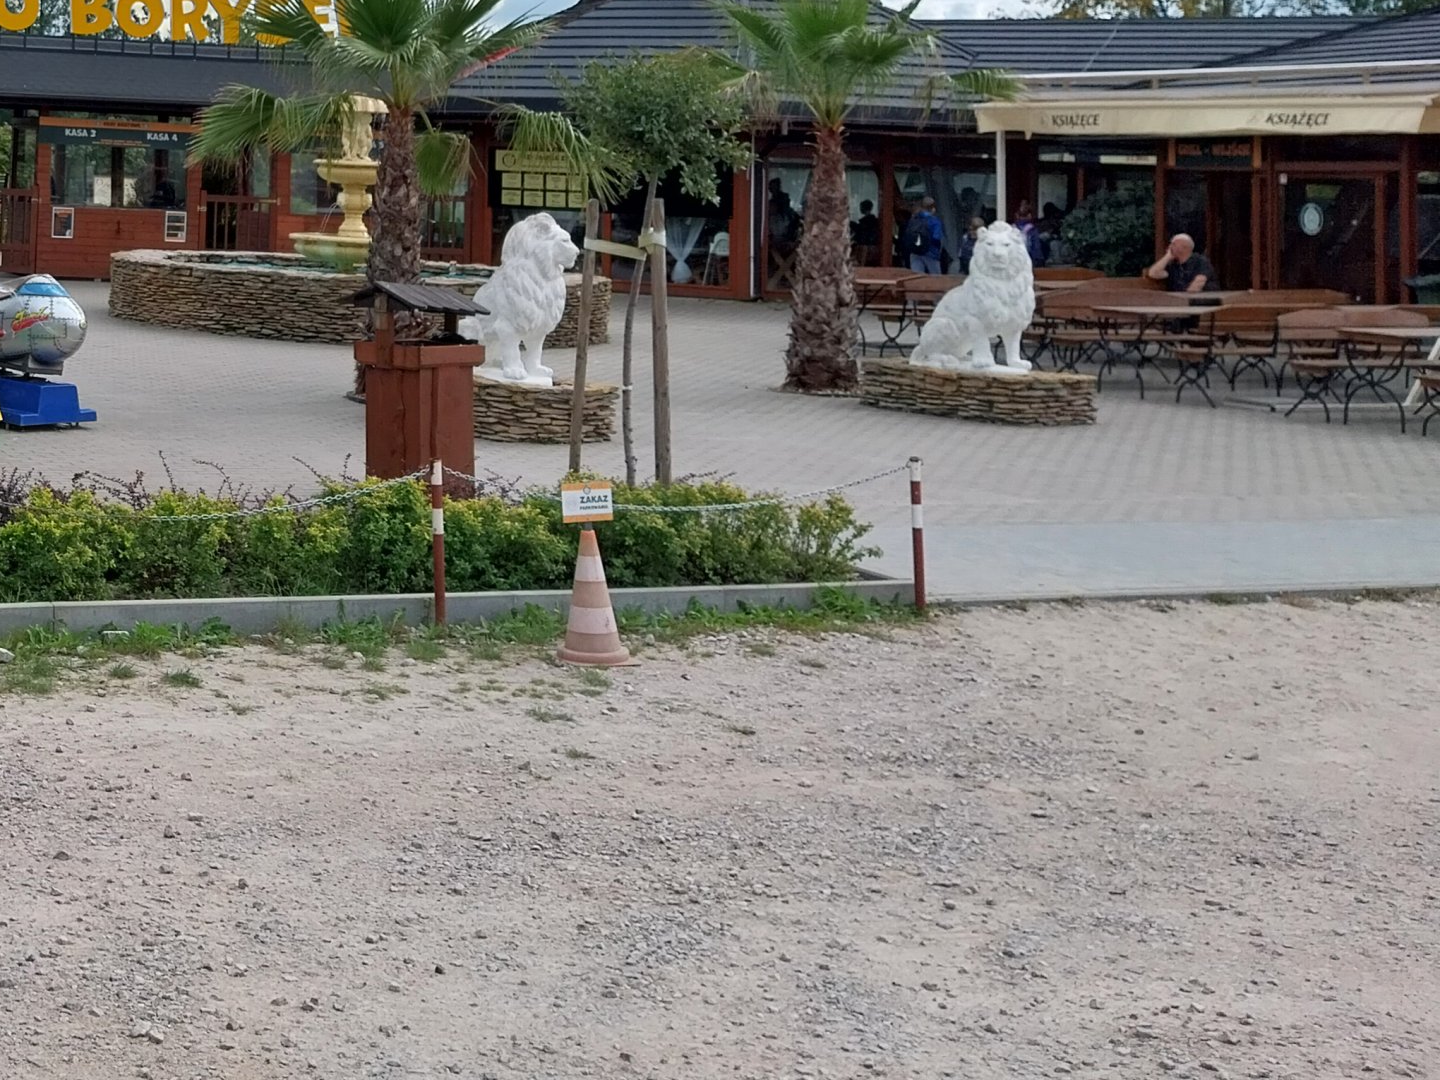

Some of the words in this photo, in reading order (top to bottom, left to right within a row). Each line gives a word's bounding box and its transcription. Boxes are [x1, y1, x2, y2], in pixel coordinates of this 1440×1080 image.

[64, 128, 88, 137] KASA
[146, 132, 169, 141] KASA
[172, 133, 178, 141] 4
[579, 495, 608, 503] ZAKAZ
